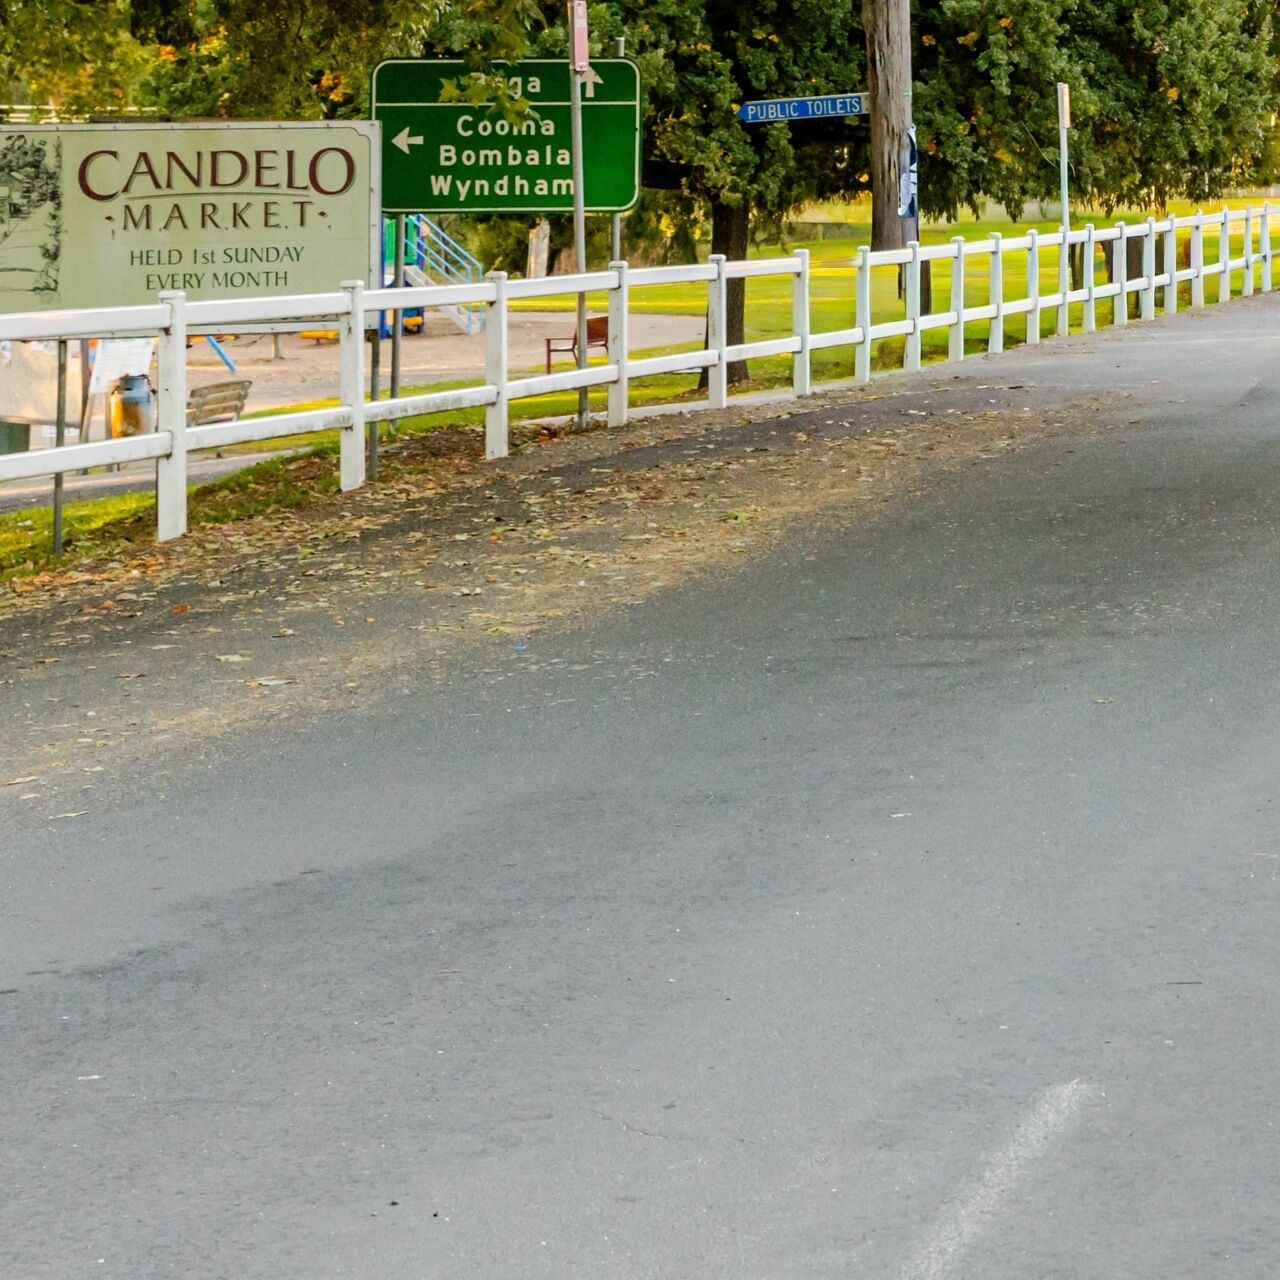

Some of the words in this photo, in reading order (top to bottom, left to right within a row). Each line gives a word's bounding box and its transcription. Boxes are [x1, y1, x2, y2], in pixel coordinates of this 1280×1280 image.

[747, 102, 799, 120] PUBLIC
[806, 97, 861, 115] TOILETS
[439, 144, 571, 166] Bombala
[78, 147, 356, 201] CANDELO
[430, 174, 575, 202] Wyndham
[122, 201, 314, 231] MARKET
[130, 248, 183, 266] HELD
[223, 246, 305, 264] SUNDAY
[146, 273, 206, 291] EVERY
[212, 270, 289, 289] MONTH
